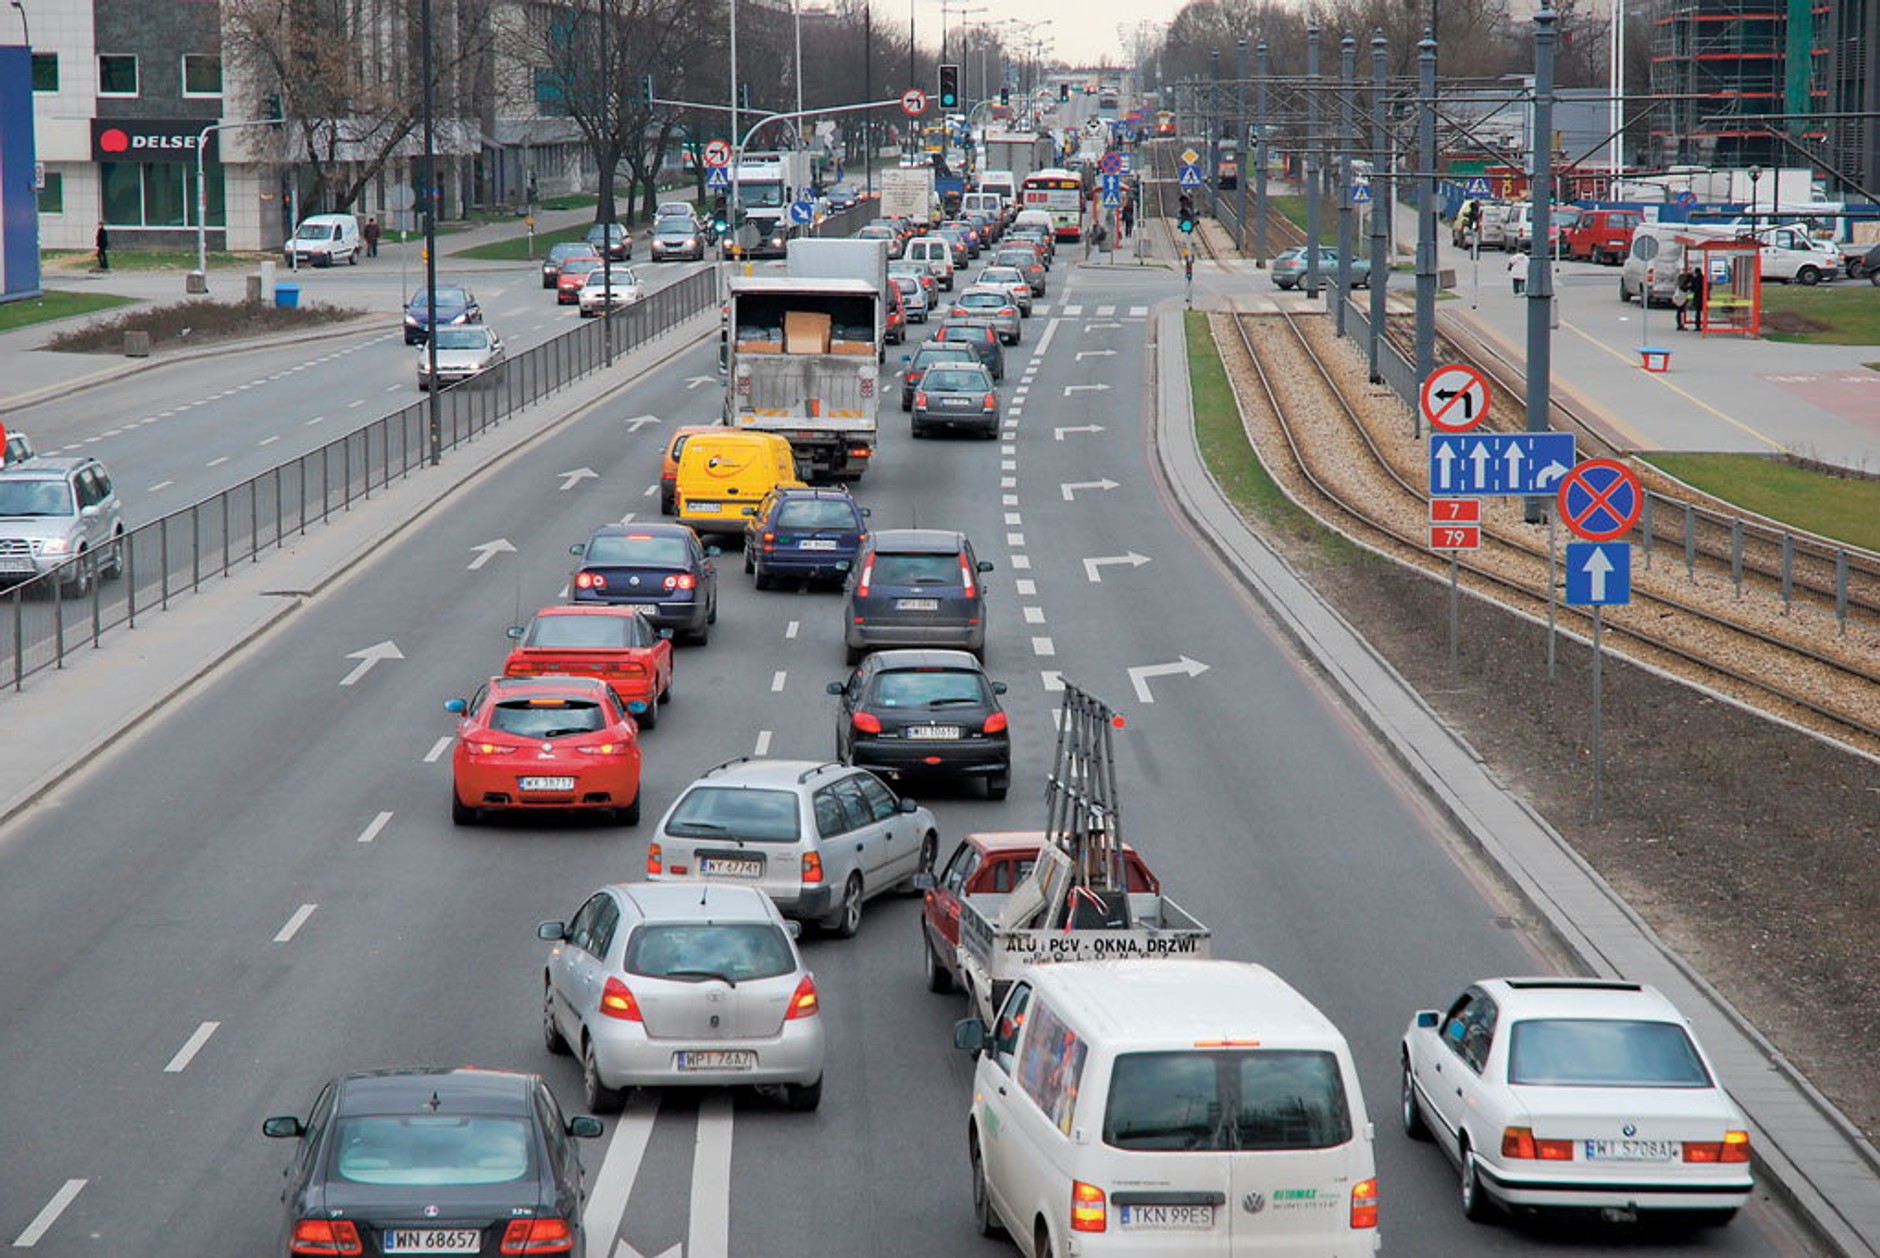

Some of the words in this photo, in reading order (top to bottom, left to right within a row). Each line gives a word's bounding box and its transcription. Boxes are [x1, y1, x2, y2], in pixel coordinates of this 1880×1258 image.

[132, 135, 208, 148] DELSEY
[1449, 503, 1459, 519] 7
[1445, 530, 1465, 546] 79
[1006, 939, 1037, 953] ALU
[1050, 938, 1080, 952] PCV
[1094, 939, 1142, 954] OKNA,
[1147, 939, 1195, 953] DRZWI
[1135, 1208, 1166, 1223] TKN
[1172, 1207, 1210, 1223] 99ES
[396, 1232, 420, 1248] WN
[425, 1232, 477, 1248] 68657
